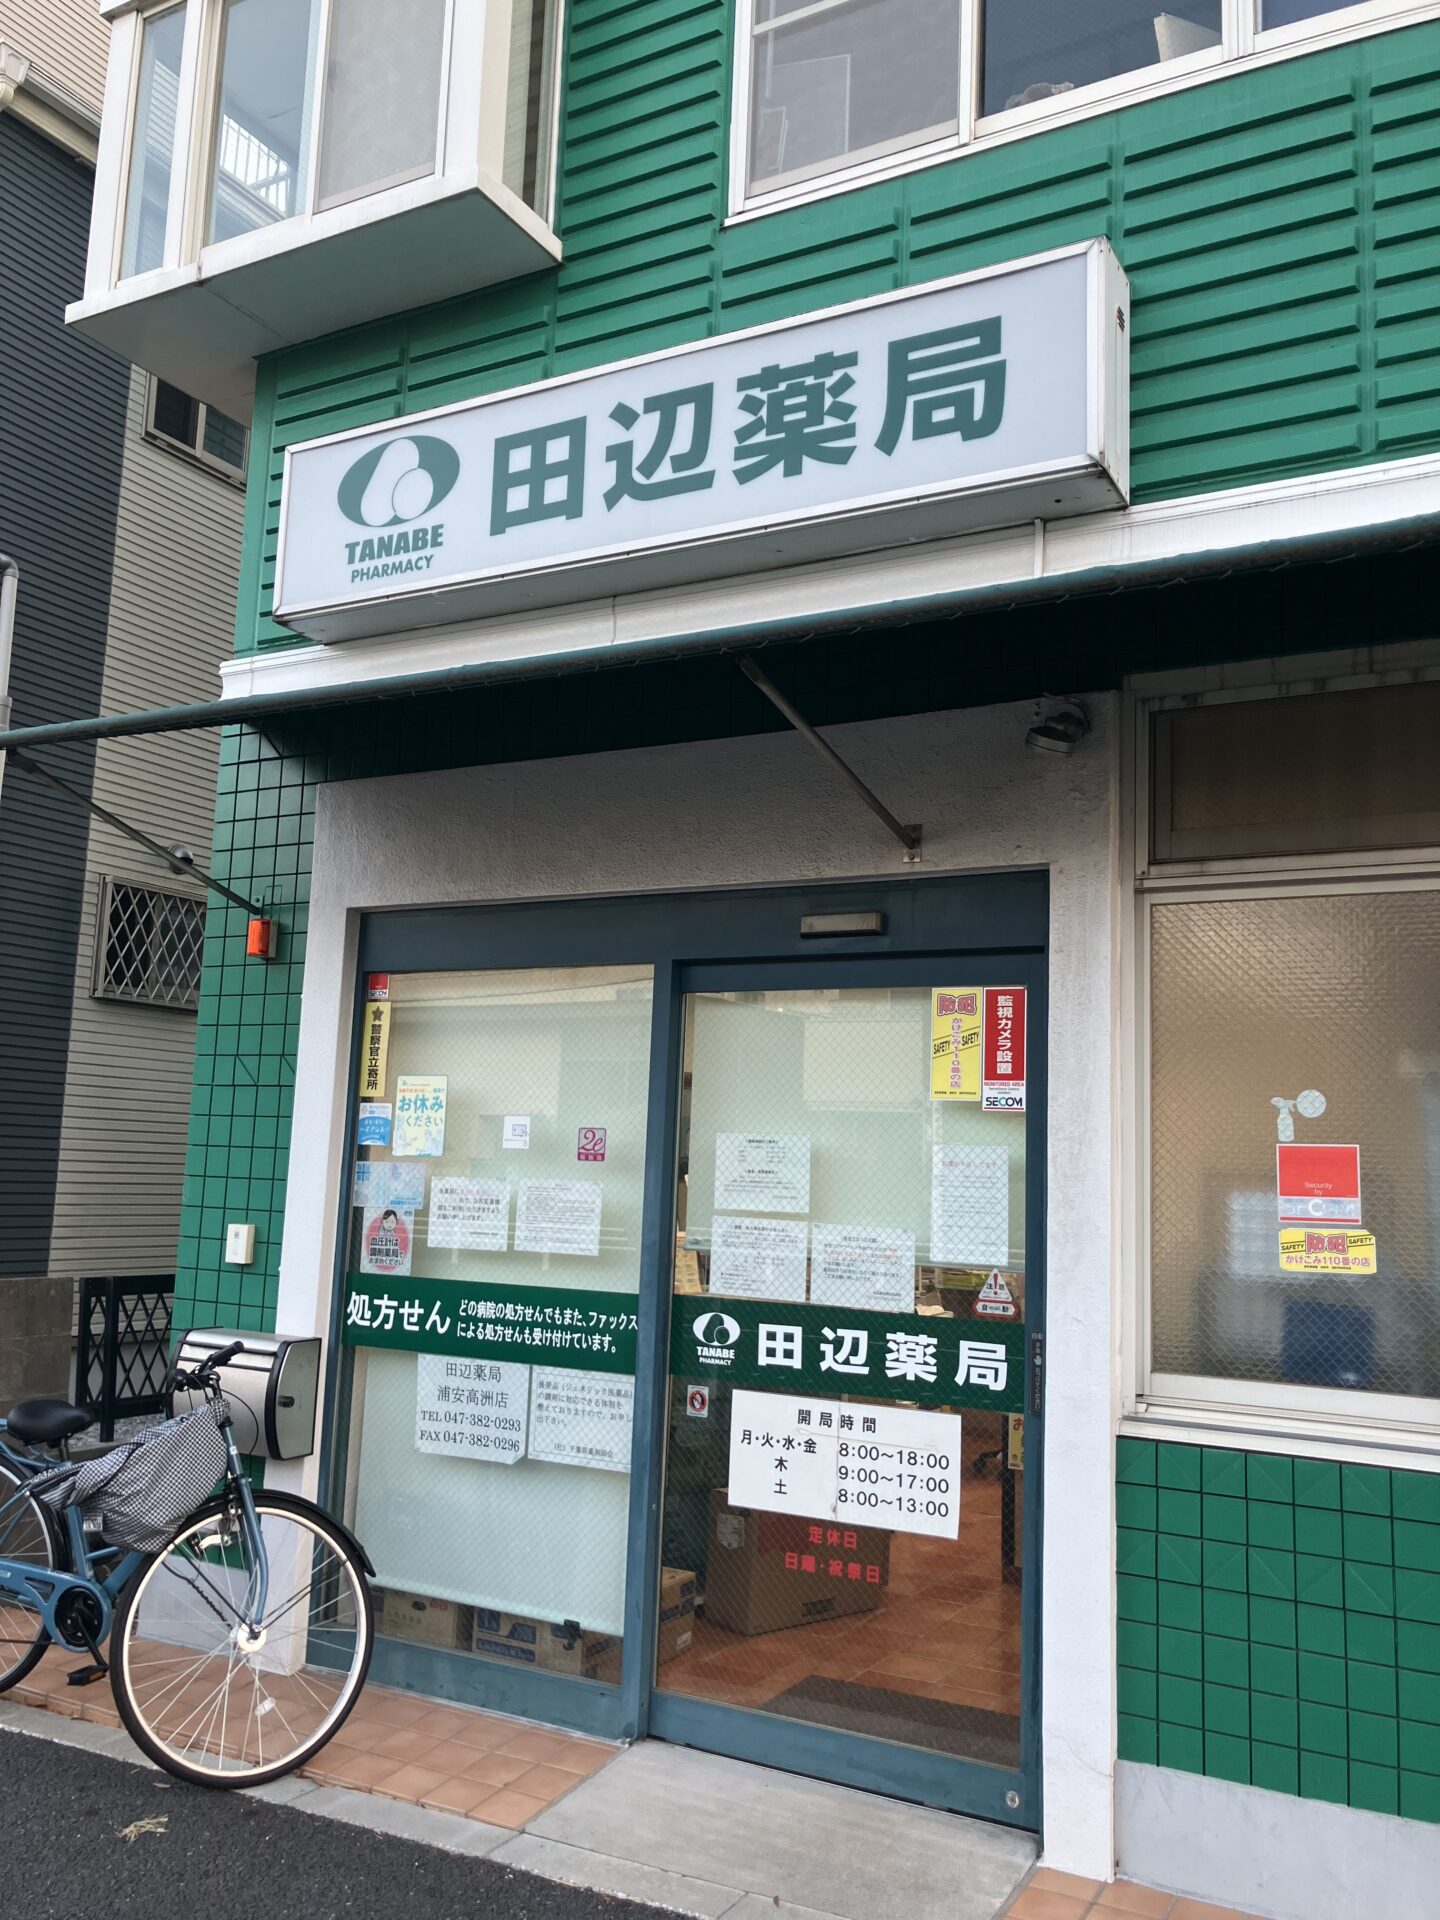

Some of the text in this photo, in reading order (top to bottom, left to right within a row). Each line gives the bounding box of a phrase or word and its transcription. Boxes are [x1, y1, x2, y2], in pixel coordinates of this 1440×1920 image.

[489, 315, 1007, 537] 田辺薬局
[345, 523, 444, 565] TANABE
[351, 554, 434, 583] PHARMACY
[961, 1032, 979, 1046] SAFETY
[996, 995, 1014, 1074] 監視カメラ設置
[366, 1023, 383, 1090] 警察官立寄所
[933, 1041, 951, 1054] SAFETY
[398, 1094, 444, 1113] お休み
[985, 1097, 1023, 1107] SECOM
[406, 1115, 444, 1127] ください
[1304, 1181, 1333, 1189] Security
[1282, 1198, 1356, 1217] SECOM
[1281, 1243, 1304, 1251] SAFETY
[1348, 1236, 1372, 1244] SAFETY
[1285, 1255, 1370, 1267] かけこみ110番の店
[347, 1291, 451, 1334] 処方せん
[458, 1299, 639, 1330] どの病院の処方せんでもまた、ファックス
[457, 1321, 616, 1353] による処方せんも受け付けています。
[696, 1346, 736, 1359] TANABE
[699, 1357, 732, 1366] PHARMACY
[758, 1323, 1008, 1391] 田辺薬局
[446, 1361, 502, 1383] 田辺薬局
[437, 1385, 510, 1409] 浦安高洲店
[421, 1410, 521, 1433] TEL 047-382-0293
[797, 1408, 877, 1434] 開局時間
[420, 1429, 520, 1453] FAX 047-382-0296
[740, 1429, 817, 1455] 月・火・水・金
[774, 1456, 788, 1472] 木
[774, 1479, 787, 1495] 土
[808, 1526, 857, 1552] 定休日
